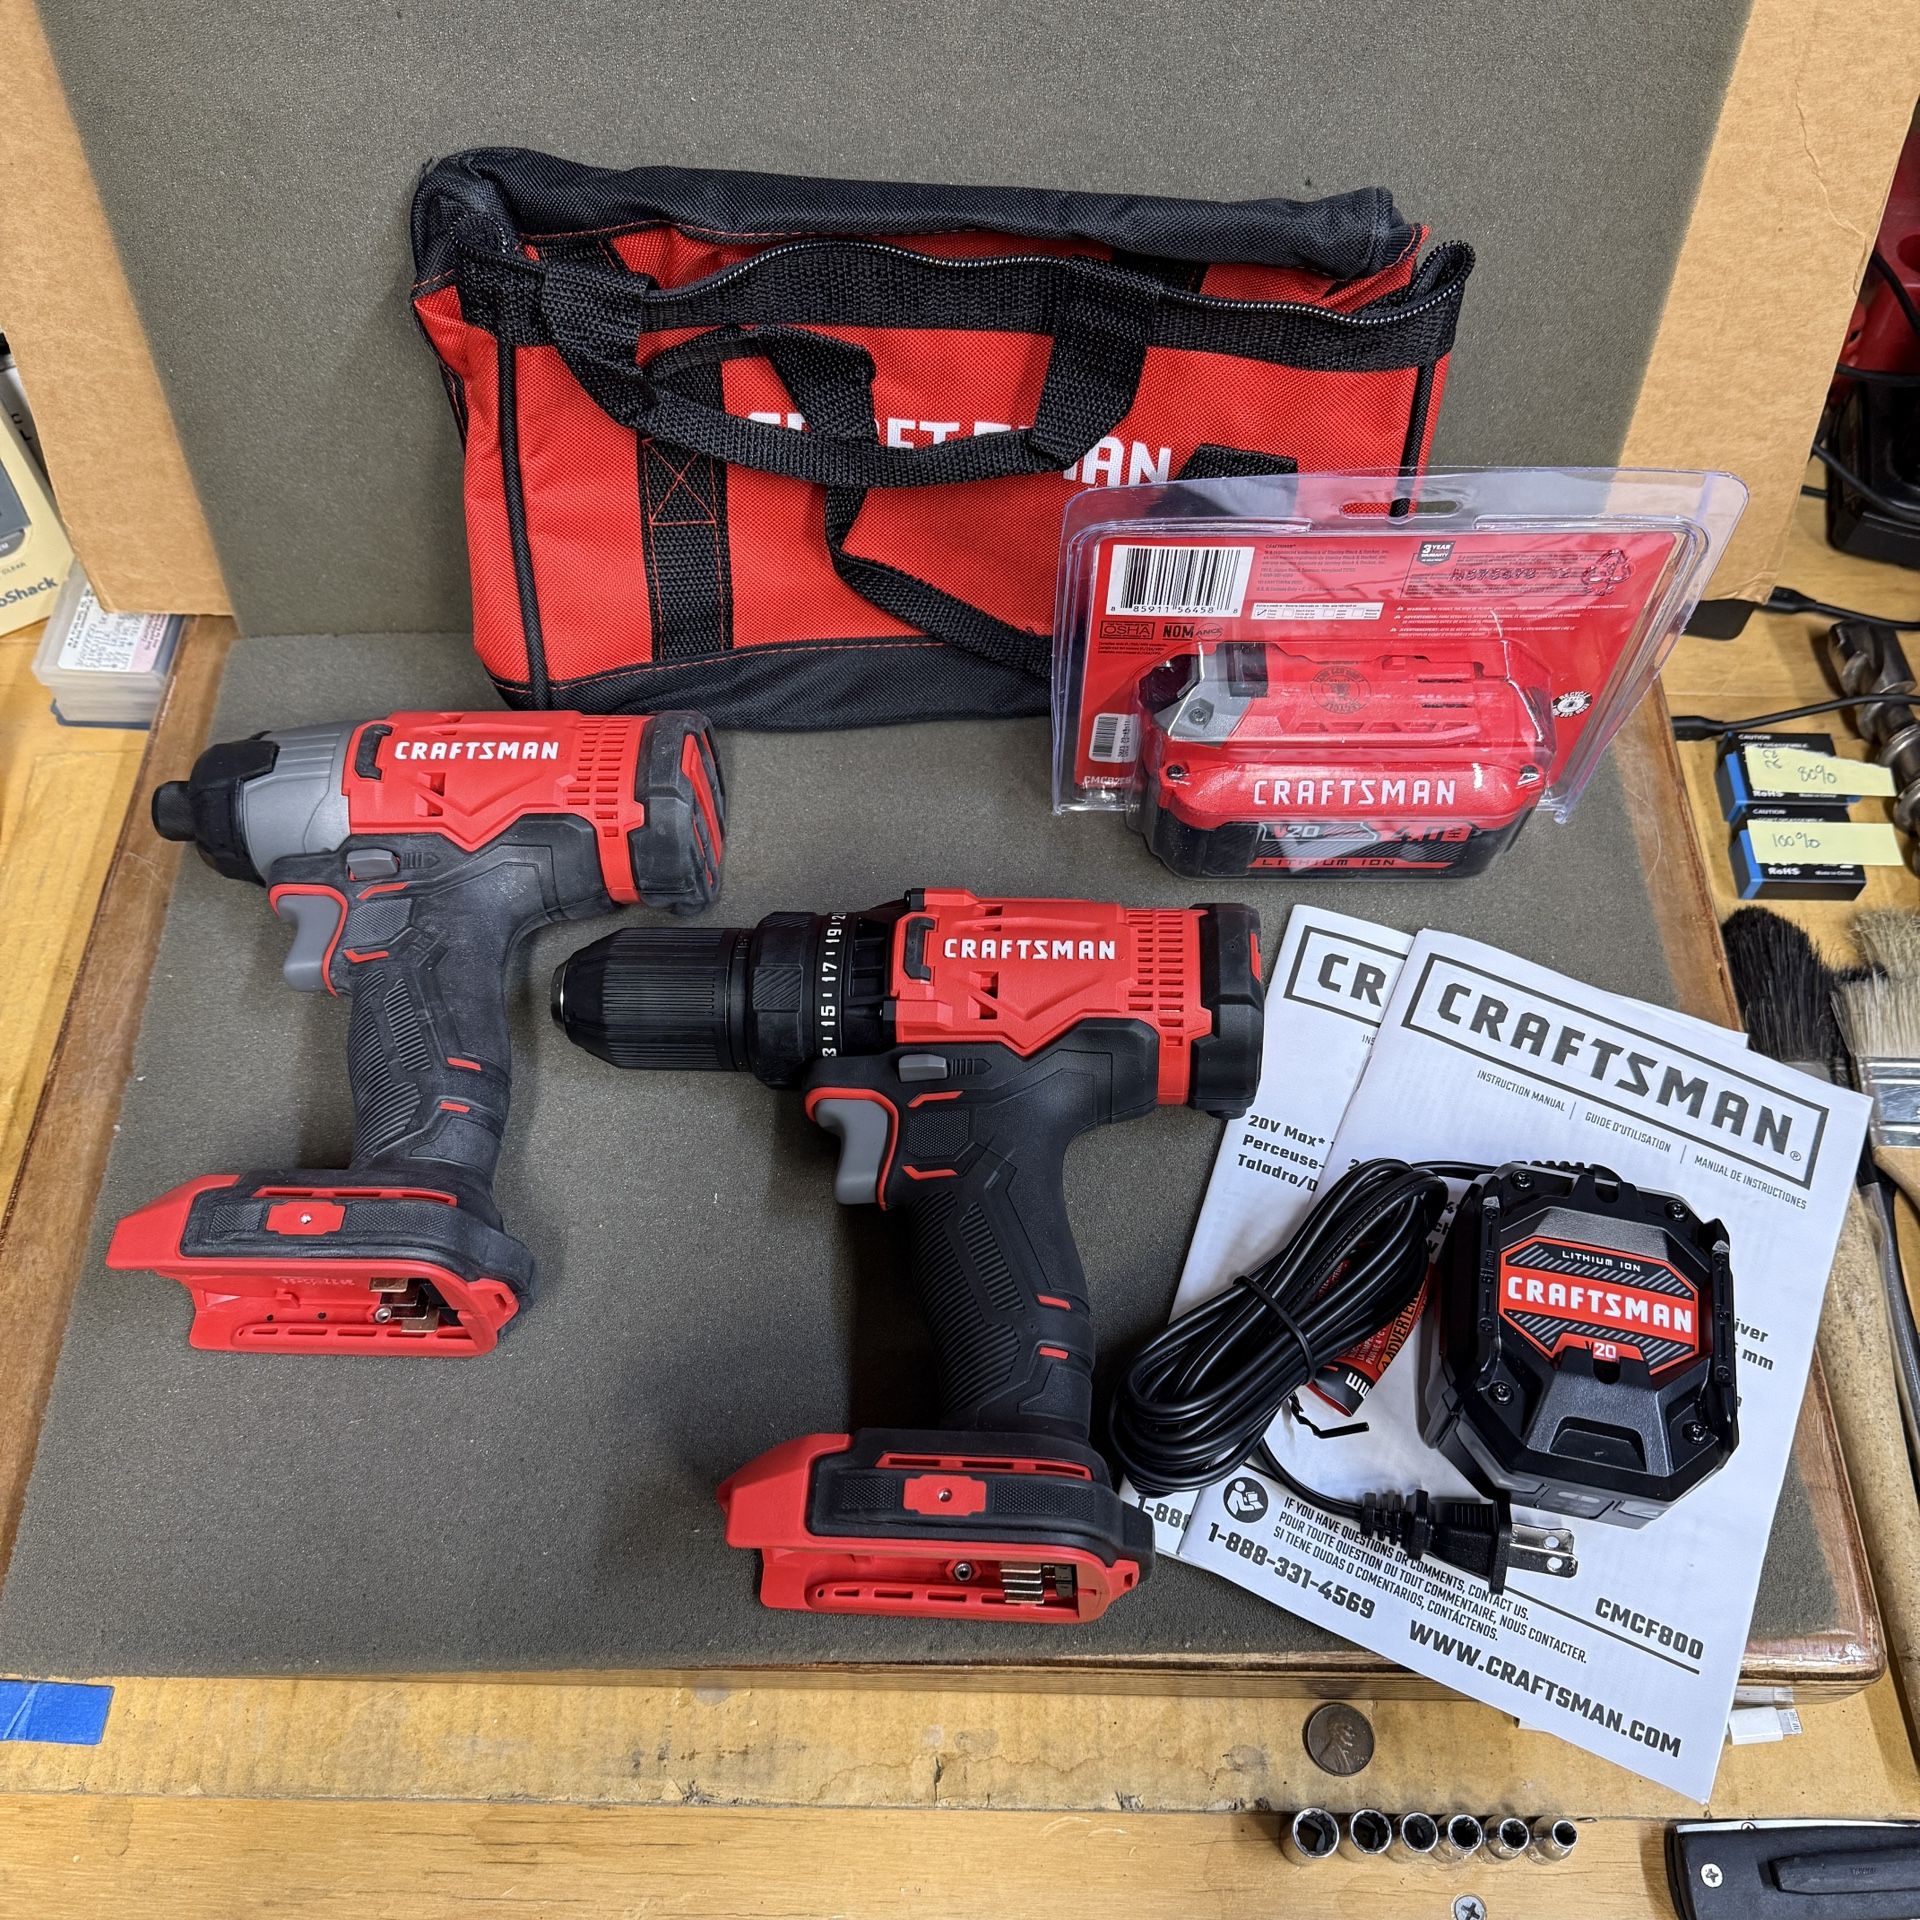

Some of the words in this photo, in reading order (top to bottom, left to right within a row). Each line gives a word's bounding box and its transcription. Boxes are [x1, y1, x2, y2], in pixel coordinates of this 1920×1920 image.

[1177, 606, 1214, 614] 56458
[1103, 625, 1150, 635] OSHA
[1163, 625, 1194, 638] NOM
[394, 741, 559, 760] CRAFTSMAN
[1254, 780, 1456, 805] CRAFTSMAN
[1273, 825, 1320, 839] V20
[1262, 859, 1348, 867] LITHIUM
[1361, 859, 1396, 867] ION
[1767, 867, 1801, 876] RoHS
[825, 928, 842, 945] 19
[944, 938, 1116, 960] CRAFTSMAN
[821, 962, 838, 983] 17
[820, 1004, 837, 1026] 15
[1476, 1068, 1531, 1102] INSTRUCTION
[1531, 1089, 1565, 1113] MANUAL
[1248, 1114, 1281, 1133] 20V
[1585, 1112, 1612, 1131] GUIDE
[1694, 1155, 1729, 1178] MANUAL
[1730, 1168, 1743, 1182] DE
[1742, 1172, 1808, 1210] INSTRUCTIONES
[1562, 1250, 1614, 1267] LITHIUM
[1620, 1261, 1641, 1272] ION
[1508, 1276, 1693, 1334] CRAFTSMAN
[1742, 1348, 1774, 1371] mm
[1284, 1496, 1294, 1510] IF
[1292, 1502, 1314, 1520] YOU
[1315, 1514, 1342, 1534] HAVE
[1342, 1525, 1394, 1560] QUESTIONS
[1395, 1550, 1409, 1566] OR
[1410, 1558, 1466, 1593] COMMENTS,
[1468, 1584, 1514, 1612] CONTACT
[1514, 1603, 1529, 1621] US.
[1208, 1521, 1376, 1619] 1-888-331-4569
[1273, 1525, 1284, 1540] SI
[1285, 1531, 1313, 1554] TIENE
[1313, 1545, 1345, 1570] DUDAS
[1346, 1562, 1355, 1574] O
[1355, 1565, 1425, 1611] COMENTARIOS,
[1427, 1599, 1498, 1641] CONTÁCTENOS.
[1278, 1511, 1306, 1533] POUR
[1307, 1522, 1336, 1548] TOUTE
[1336, 1540, 1383, 1569] QUESTION
[1384, 1562, 1399, 1577] OU
[1399, 1569, 1424, 1589] TOUT
[1424, 1578, 1497, 1625] COMMENTAIRE,
[1500, 1614, 1527, 1636] NOUS
[1528, 1627, 1587, 1664] CONTACTER.
[1595, 1597, 1704, 1660] CMCF800
[1409, 1619, 1682, 1758] WWW.CRAFTSMAN.COM
